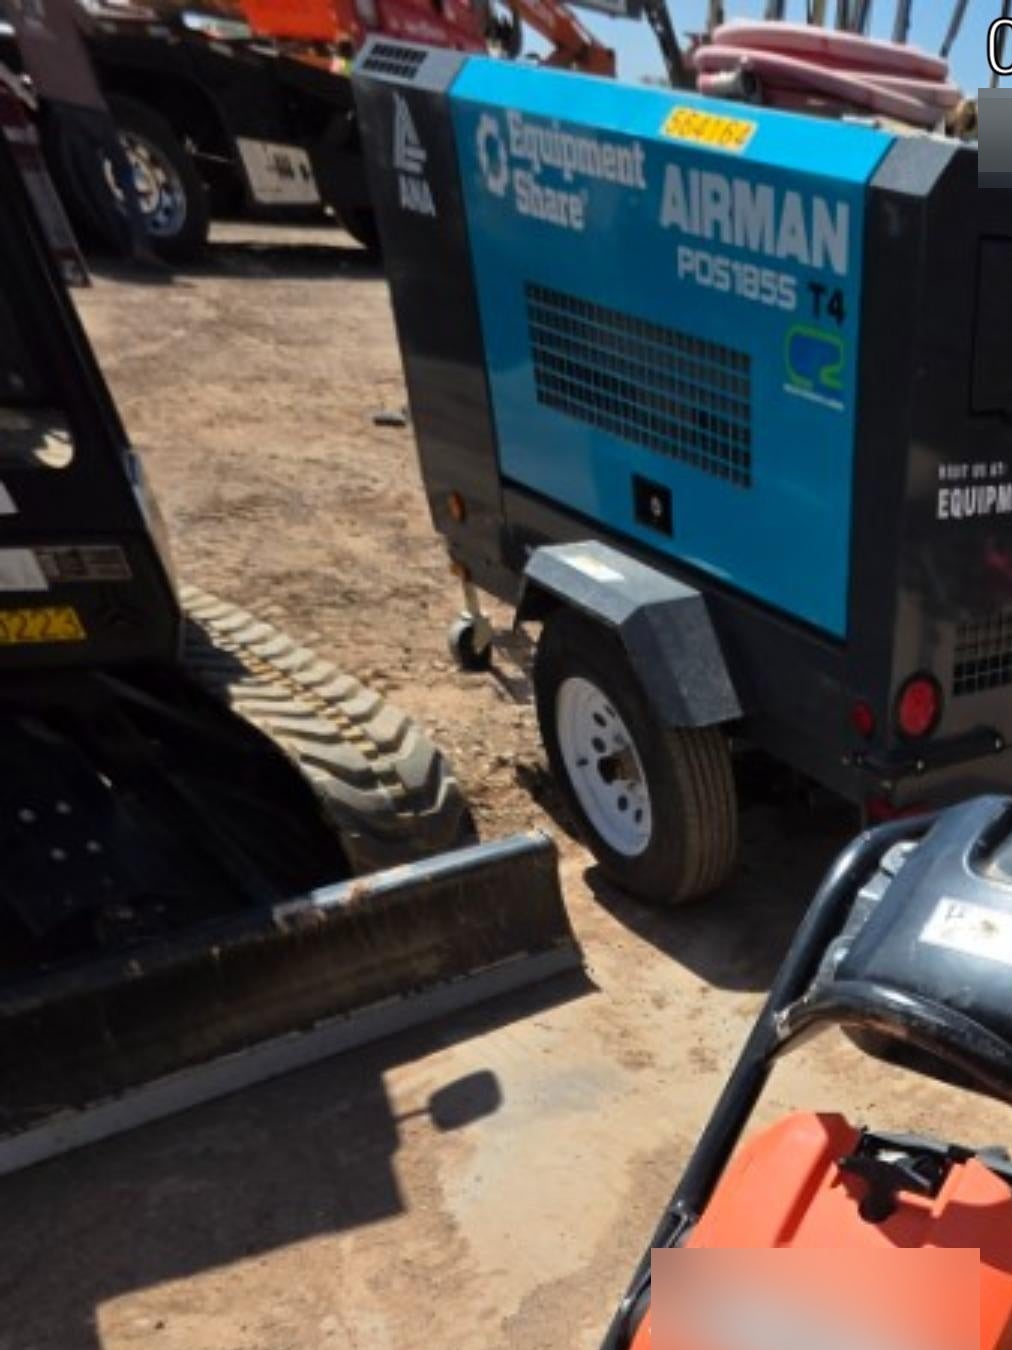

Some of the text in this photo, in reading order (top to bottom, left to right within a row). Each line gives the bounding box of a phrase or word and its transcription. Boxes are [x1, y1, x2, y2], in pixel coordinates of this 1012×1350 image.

[507, 108, 647, 189] Equipment
[398, 173, 436, 218] ANA
[514, 169, 585, 231] Share
[660, 163, 850, 277] AIRMAN
